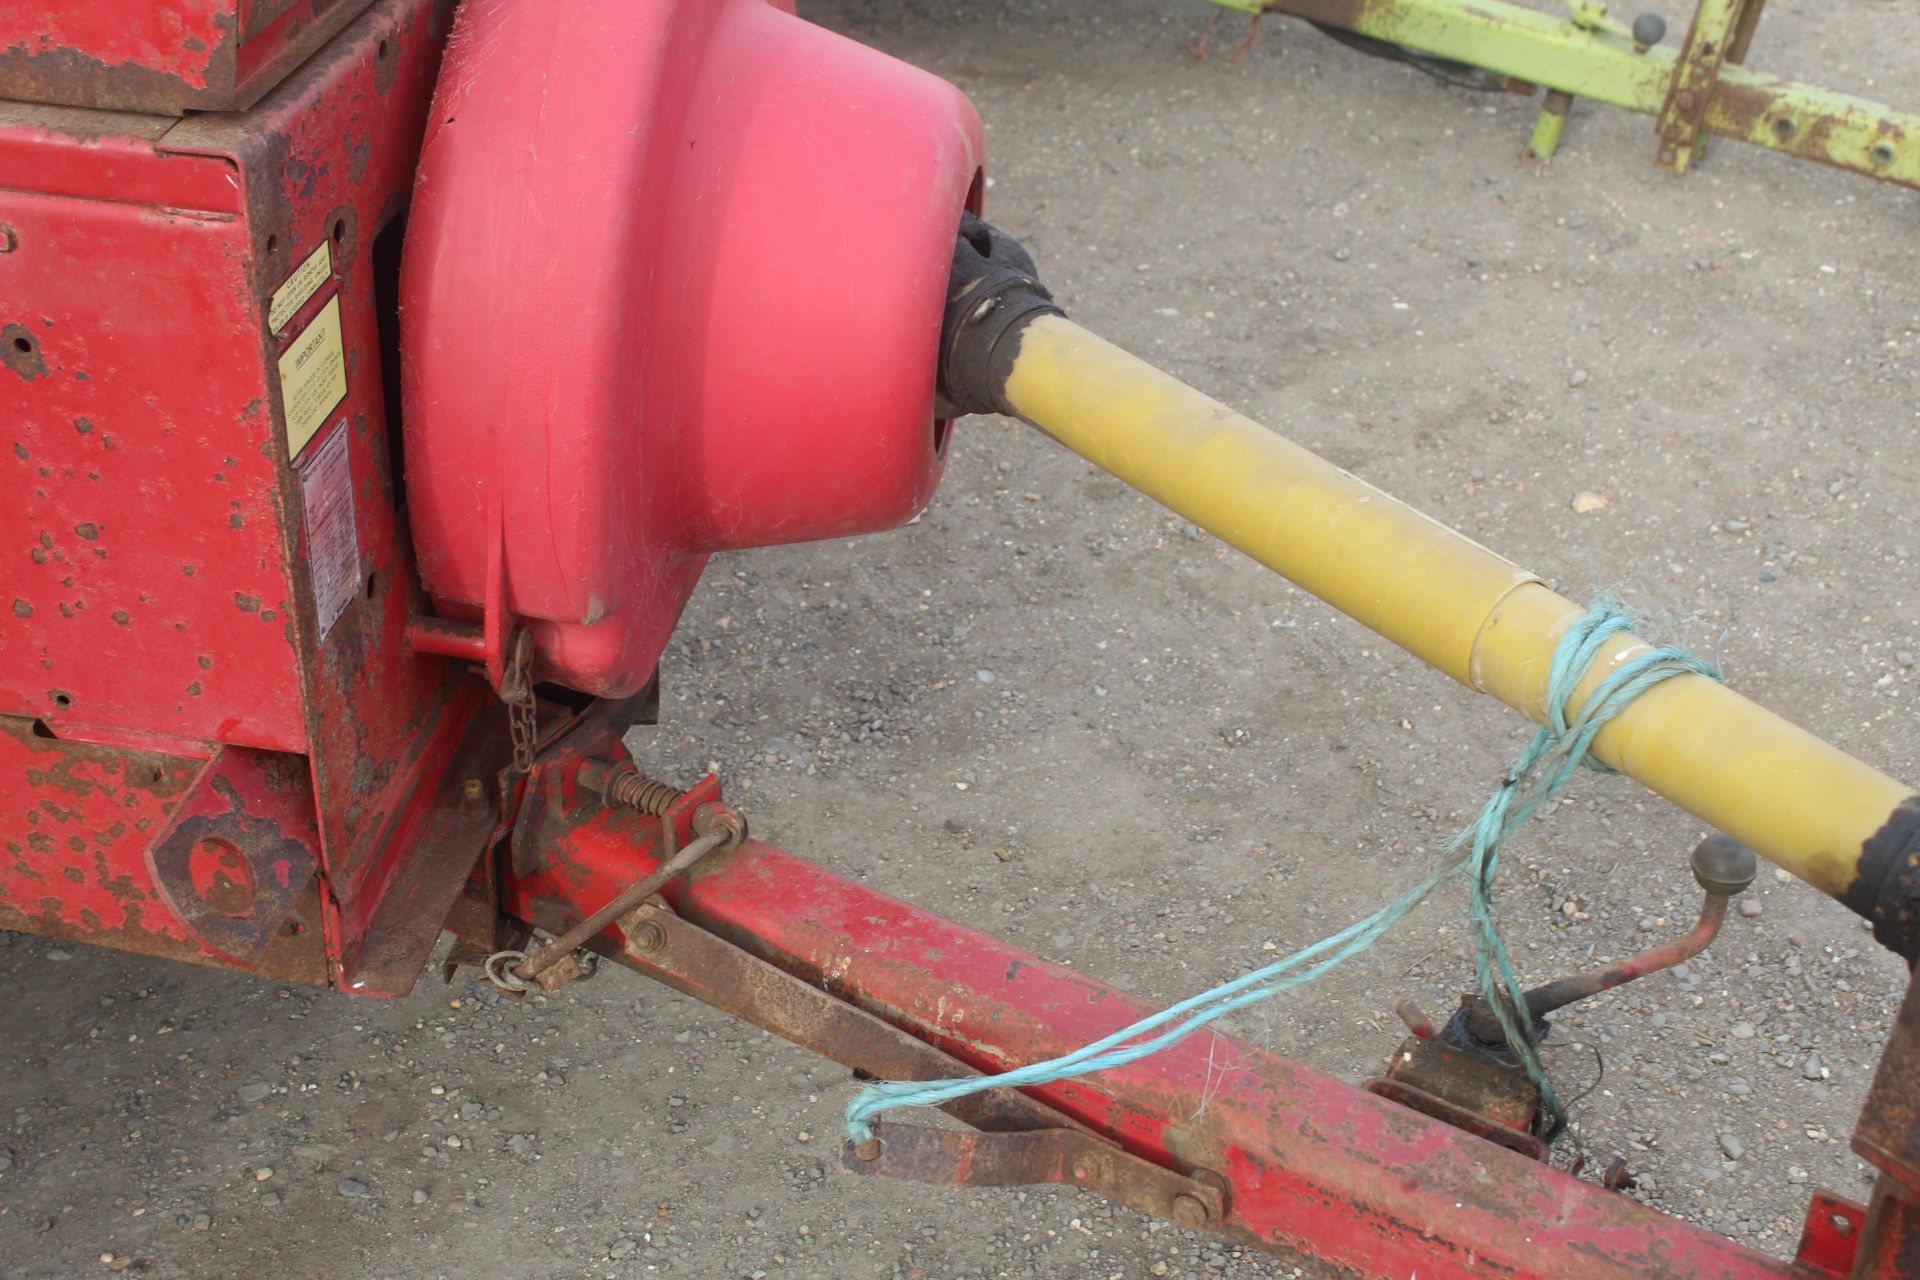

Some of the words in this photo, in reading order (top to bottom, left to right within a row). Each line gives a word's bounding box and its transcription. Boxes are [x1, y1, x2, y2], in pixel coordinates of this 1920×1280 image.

[286, 285, 297, 299] OPEN
[303, 264, 318, 281] REMOVE
[287, 262, 310, 288] CAUTION
[295, 328, 326, 368] IMPORTANT
